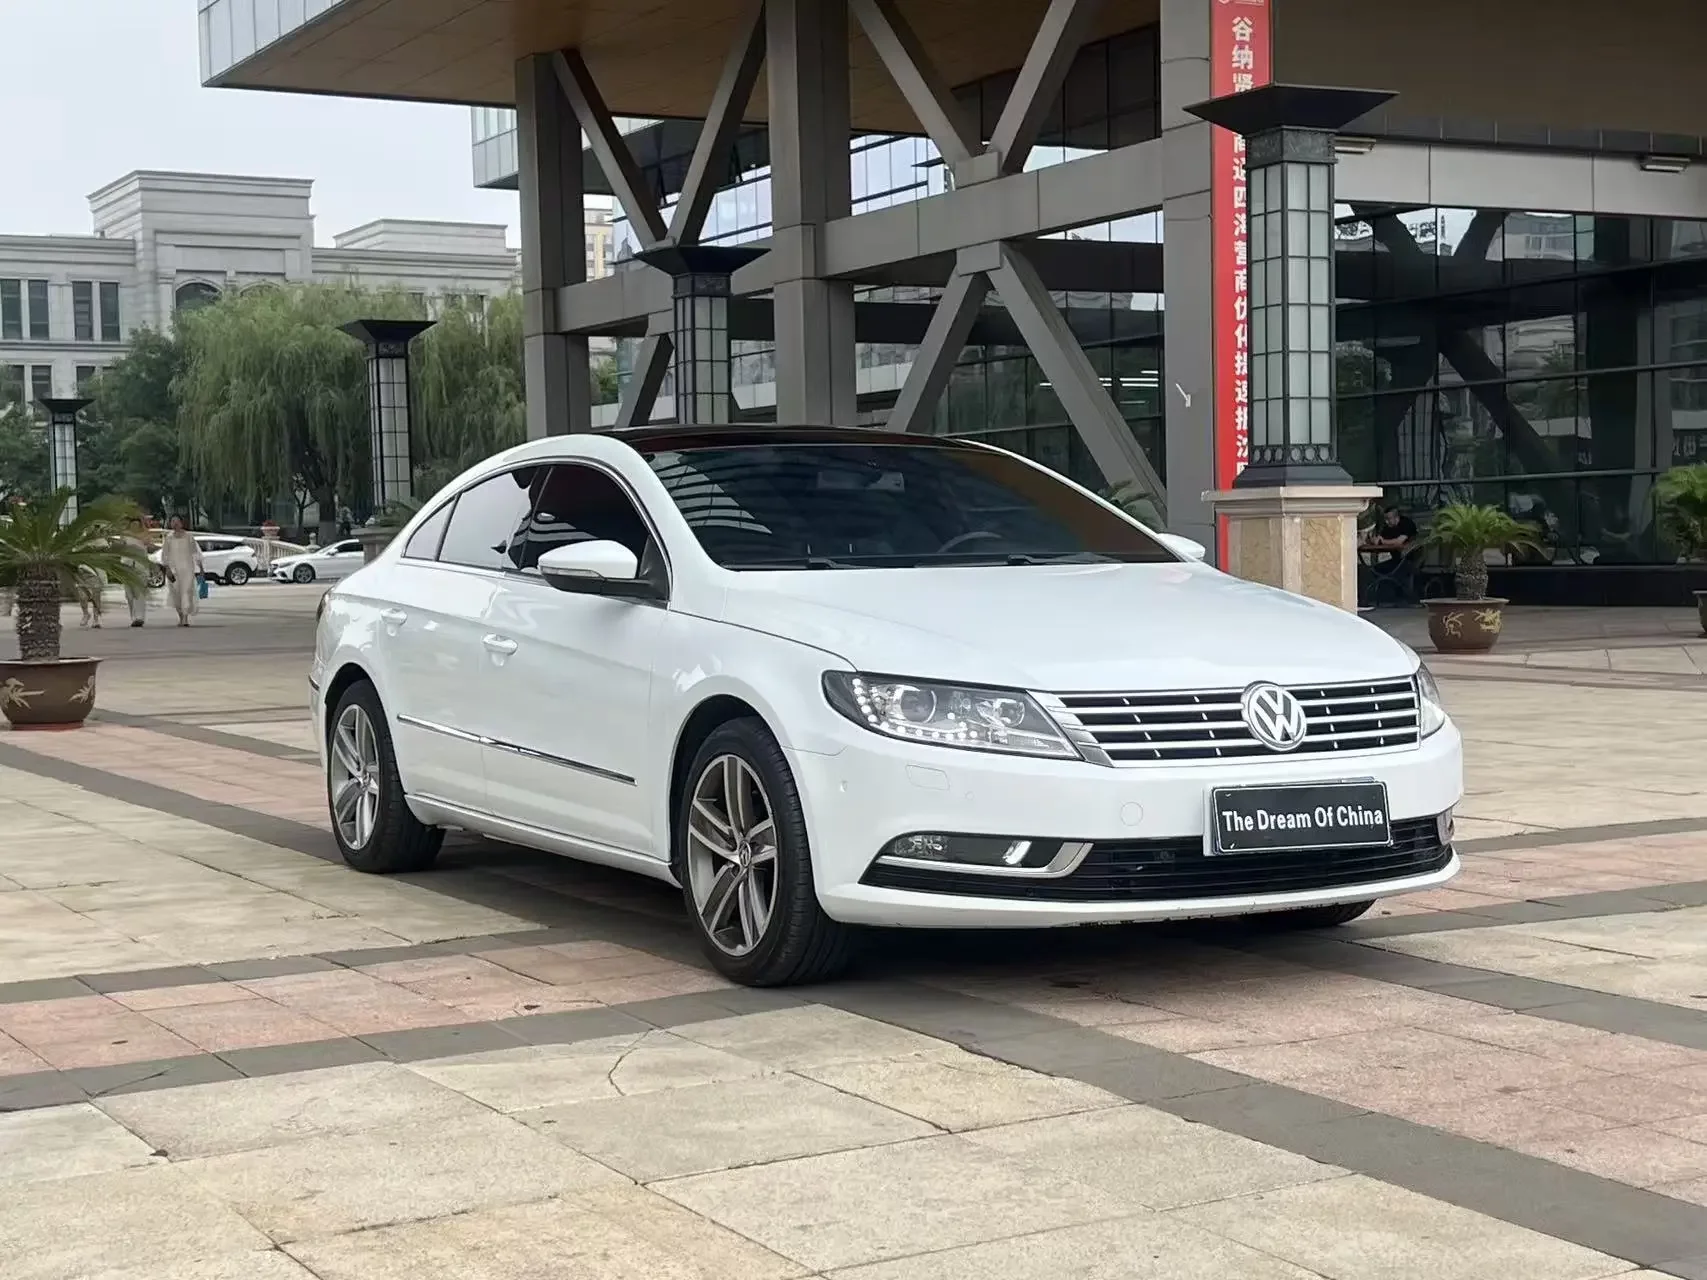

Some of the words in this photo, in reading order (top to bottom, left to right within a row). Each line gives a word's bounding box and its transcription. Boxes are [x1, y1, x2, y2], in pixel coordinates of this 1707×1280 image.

[1248, 683, 1306, 747] VW
[1222, 811, 1254, 831] The
[1256, 809, 1312, 830] Dream
[1314, 806, 1333, 827] Of
[1337, 805, 1383, 826] China
